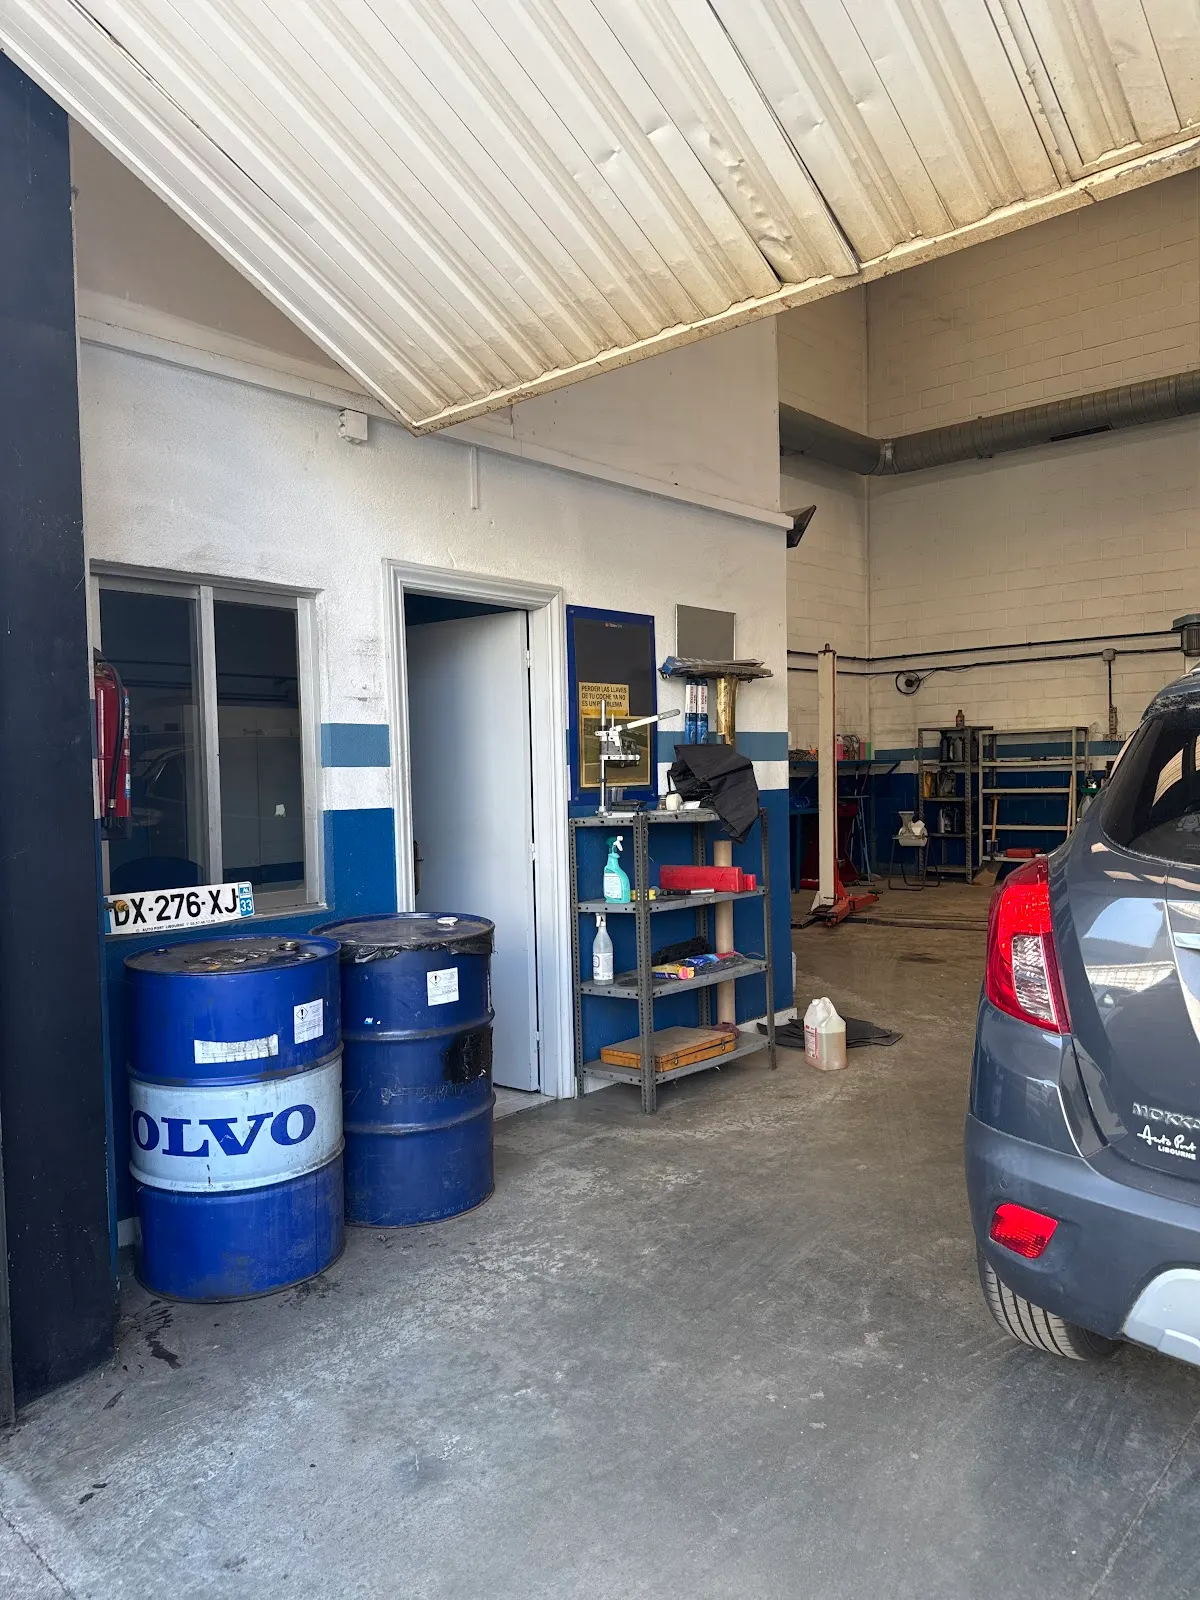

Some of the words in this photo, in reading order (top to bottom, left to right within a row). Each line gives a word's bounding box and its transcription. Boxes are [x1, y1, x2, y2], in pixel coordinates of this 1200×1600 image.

[113, 888, 239, 927] DX-276-XJ
[240, 899, 252, 912] 33
[130, 1103, 316, 1157] OLVO
[1136, 1124, 1172, 1146] Auto
[1157, 1144, 1197, 1160] LIBOURNE
